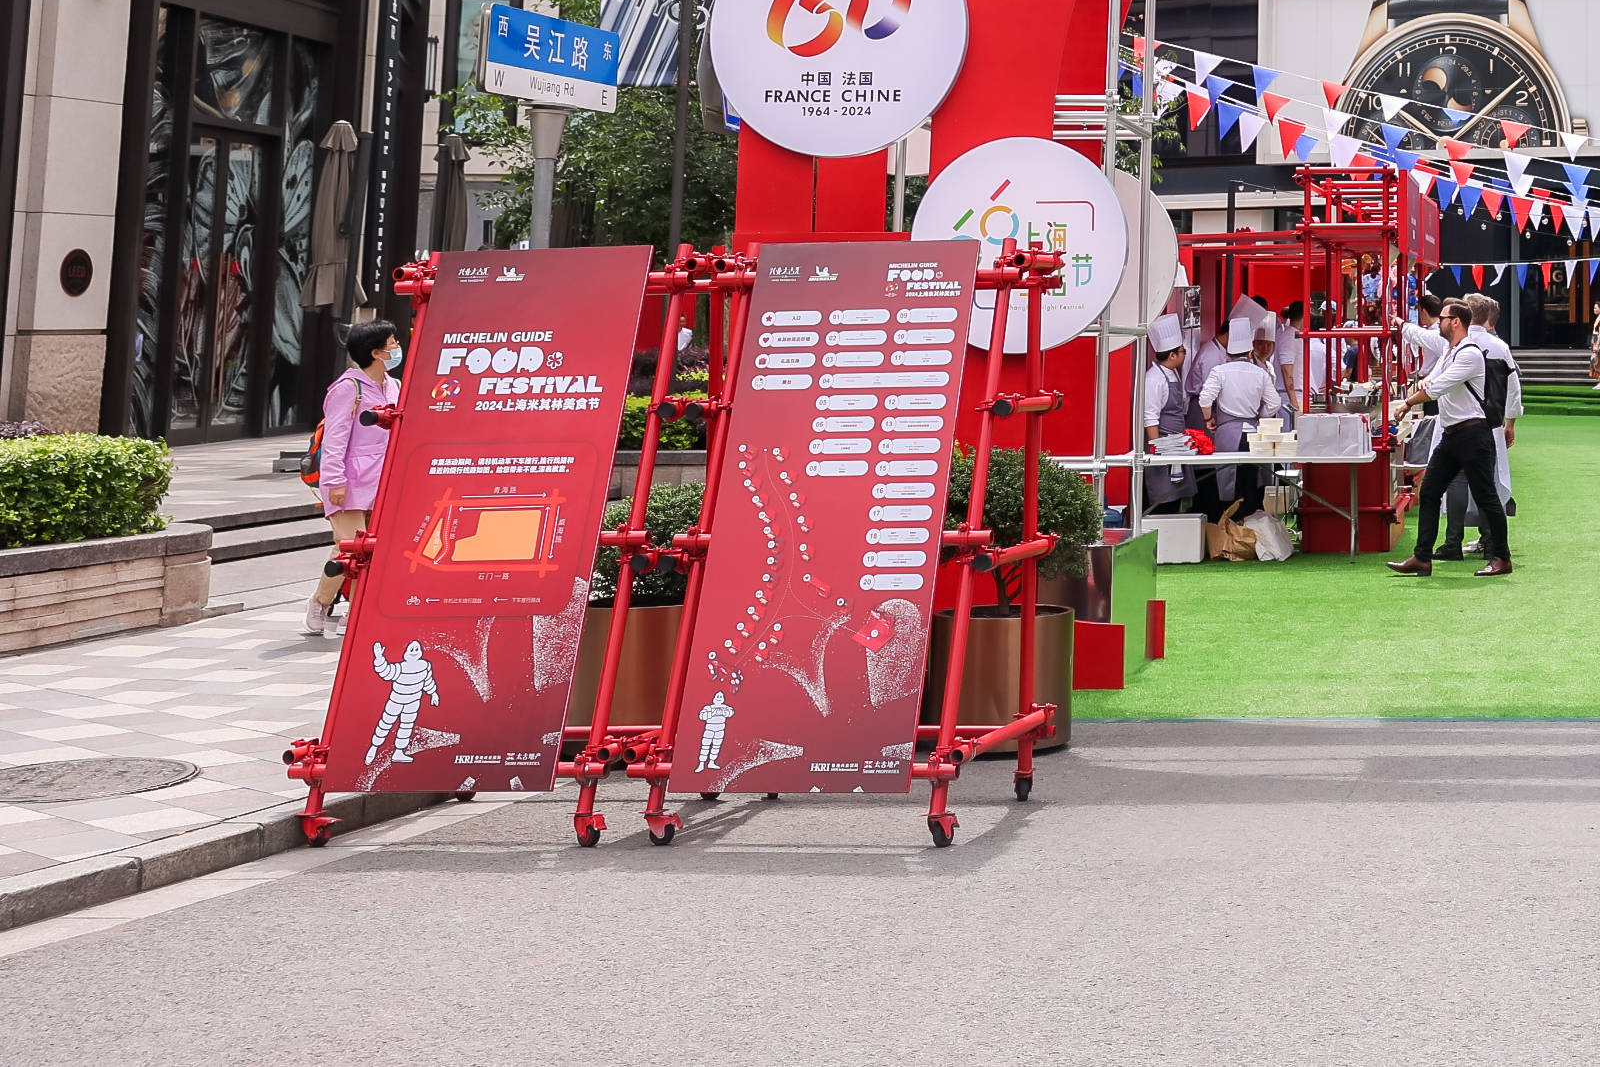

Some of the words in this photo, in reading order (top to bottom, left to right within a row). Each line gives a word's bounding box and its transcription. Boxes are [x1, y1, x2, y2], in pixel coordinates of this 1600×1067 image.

[498, 15, 509, 38] 西
[523, 24, 589, 72] 吴江路
[603, 41, 612, 61] 东
[801, 72, 831, 86] 中国
[842, 72, 873, 86] 法国
[494, 69, 505, 88] W
[529, 75, 561, 97] Wujiang
[601, 89, 608, 106] E
[765, 89, 831, 103] FRANCE
[841, 89, 901, 102] CHINE
[802, 106, 830, 116] 1964
[841, 106, 872, 116] 2024
[887, 269, 935, 282] FOOD
[443, 333, 508, 344] MICHELIN
[511, 331, 553, 342] GUIDE
[437, 347, 544, 374] FOOD
[475, 398, 600, 412] 2024上海米其林美食节
